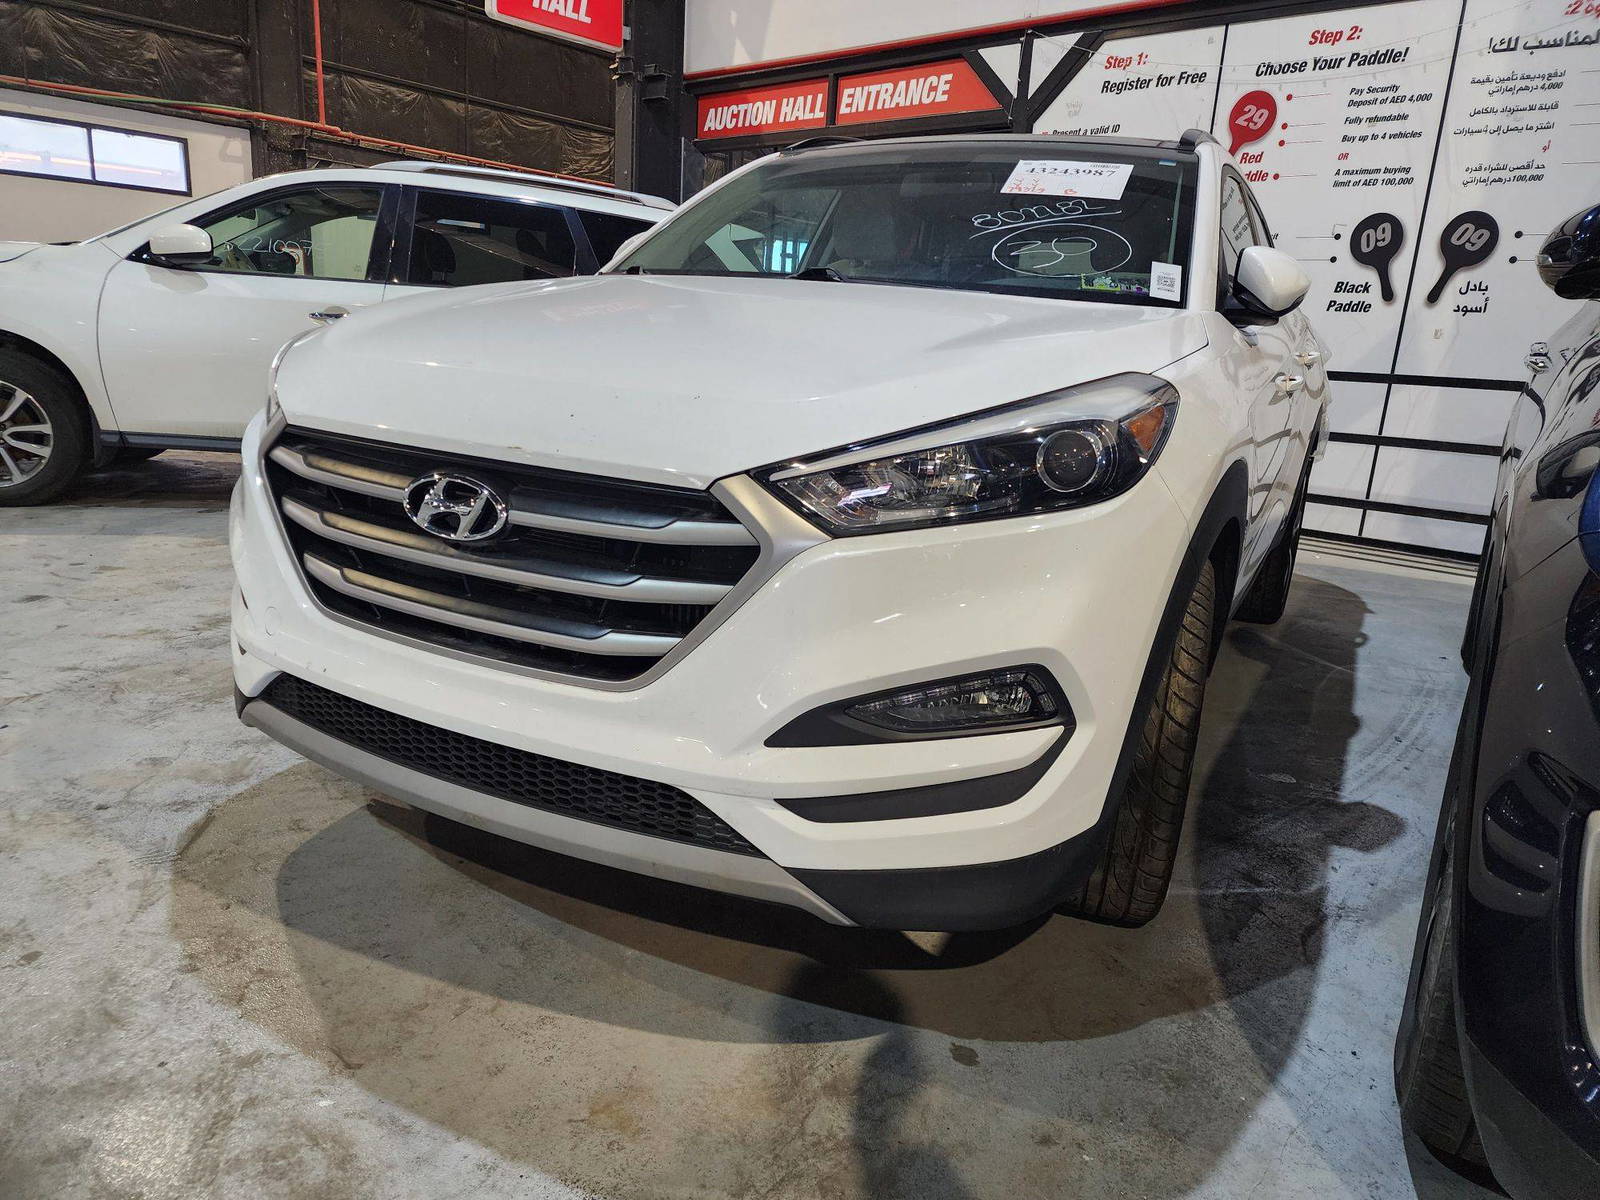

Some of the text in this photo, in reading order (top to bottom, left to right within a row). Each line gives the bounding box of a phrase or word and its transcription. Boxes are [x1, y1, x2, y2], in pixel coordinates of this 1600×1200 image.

[1308, 25, 1363, 45] Step 2:
[1487, 36, 1520, 53] لك!
[1104, 52, 1149, 70] Step 1:
[1255, 47, 1410, 77] Choose Your Paddle!
[1519, 72, 1546, 81] وديعة
[1546, 68, 1566, 81] ادفع
[1101, 70, 1207, 95] Register for Free
[1540, 82, 1563, 91] 4,000
[839, 73, 954, 115] ENTRANCE
[1349, 84, 1400, 96] Pay Security
[1347, 93, 1432, 108] Deposit of AED 4,000
[703, 93, 824, 132] AUCTION HALL
[1235, 104, 1269, 130] 29
[1469, 106, 1498, 117] بالكامل
[1344, 112, 1409, 126] Fully refundable
[1090, 125, 1110, 135] valid
[1111, 123, 1121, 134] ID
[1341, 130, 1422, 144] Buy up to 4 vehicles
[1239, 151, 1264, 164] Red
[1337, 152, 1349, 160] OR
[1334, 165, 1411, 176] A maximum buying
[1333, 177, 1414, 188] limit of AED 100,000
[1360, 222, 1392, 253] 09
[1450, 222, 1490, 252] 09
[1333, 281, 1372, 294] Black
[1459, 280, 1489, 295] بادل
[1326, 300, 1372, 313] Paddle
[1453, 297, 1489, 317] أسود
